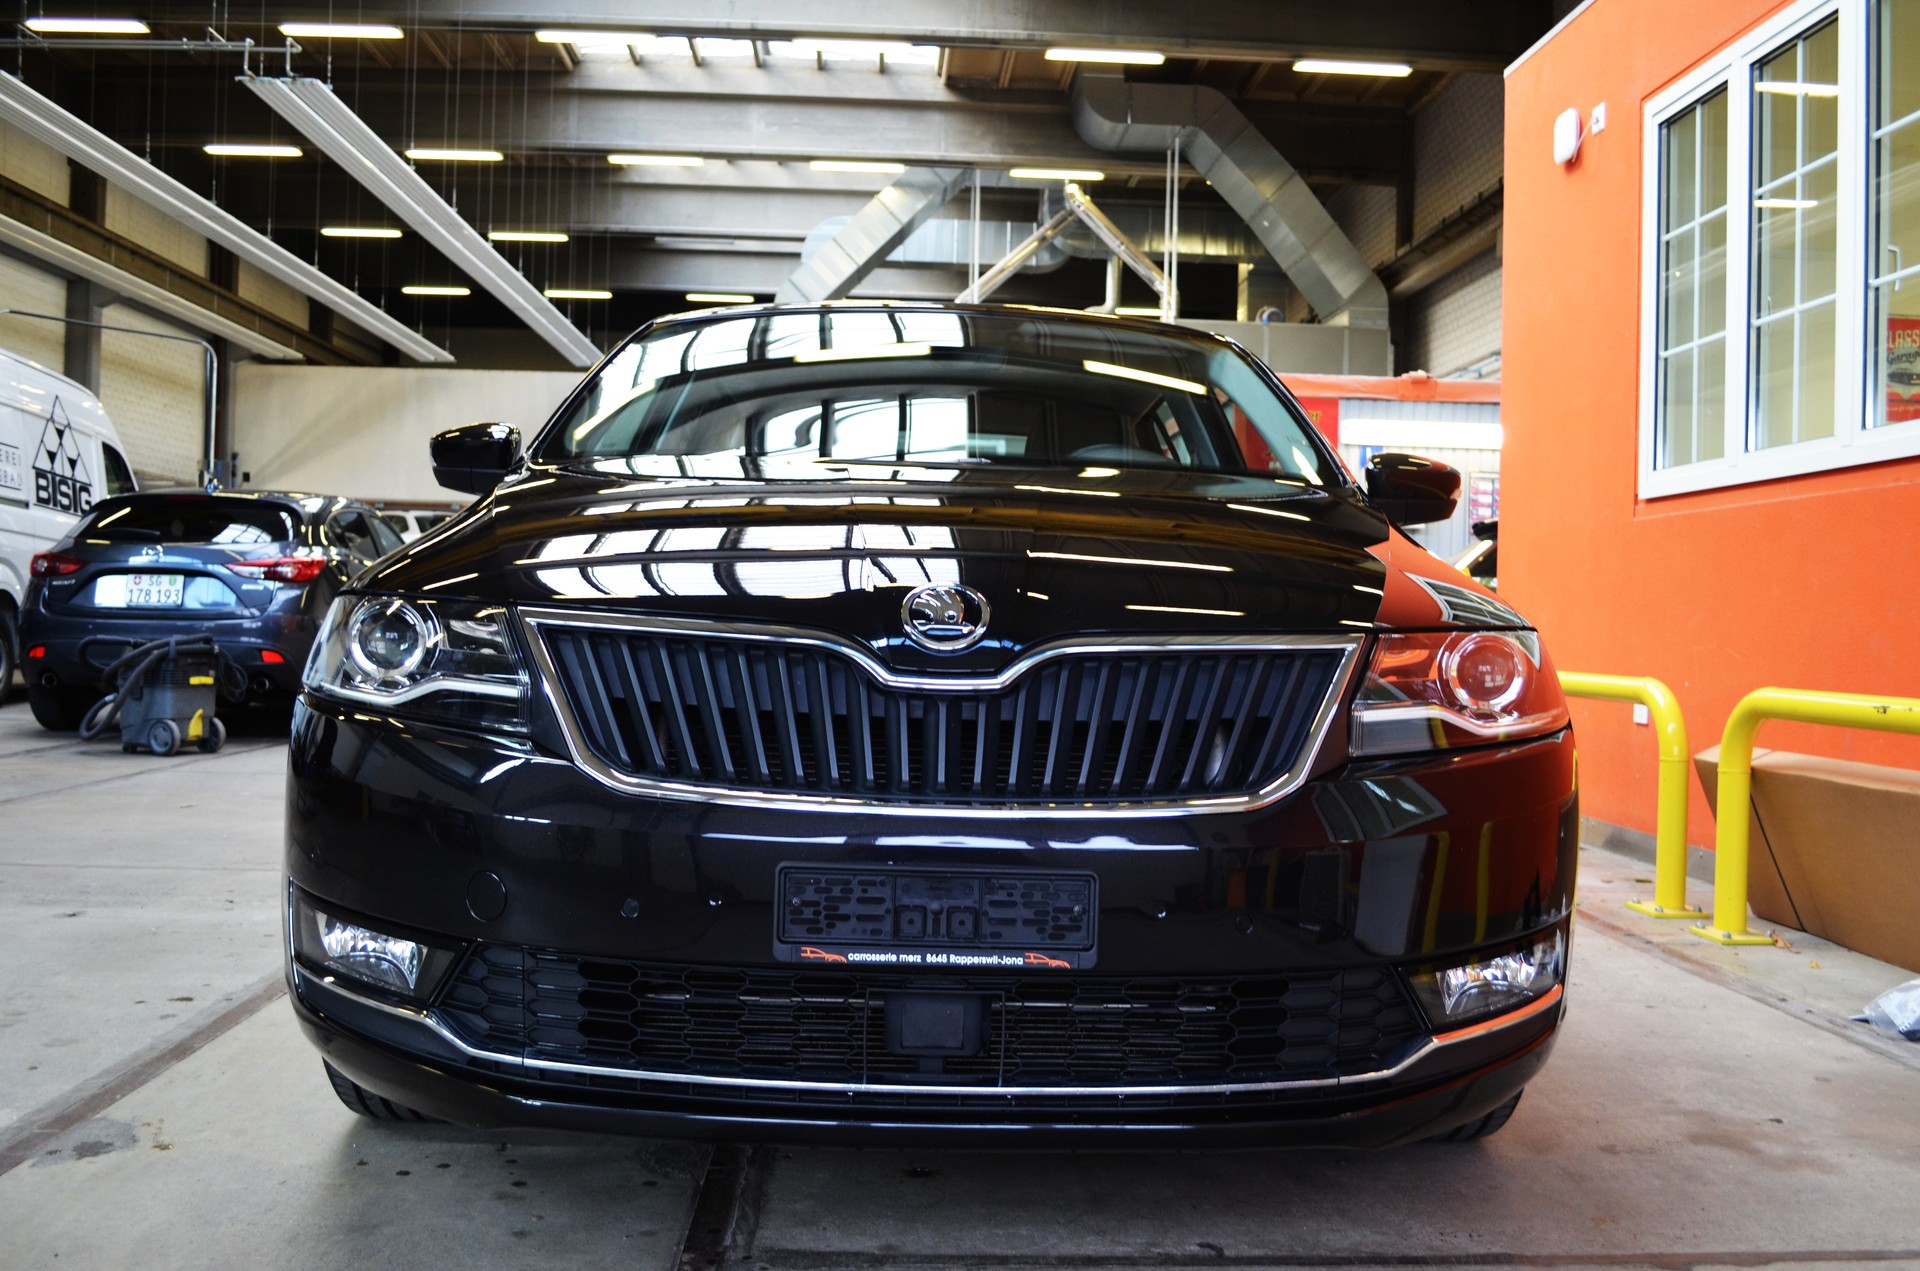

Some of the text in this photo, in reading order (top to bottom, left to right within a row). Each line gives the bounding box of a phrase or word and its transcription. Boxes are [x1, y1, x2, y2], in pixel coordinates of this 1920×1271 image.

[35, 470, 92, 515] BISIG
[148, 575, 162, 586] SG
[128, 588, 180, 604] 178 193
[847, 952, 1023, 965] carrosserie merz 8645 Rapperswil-Jona
